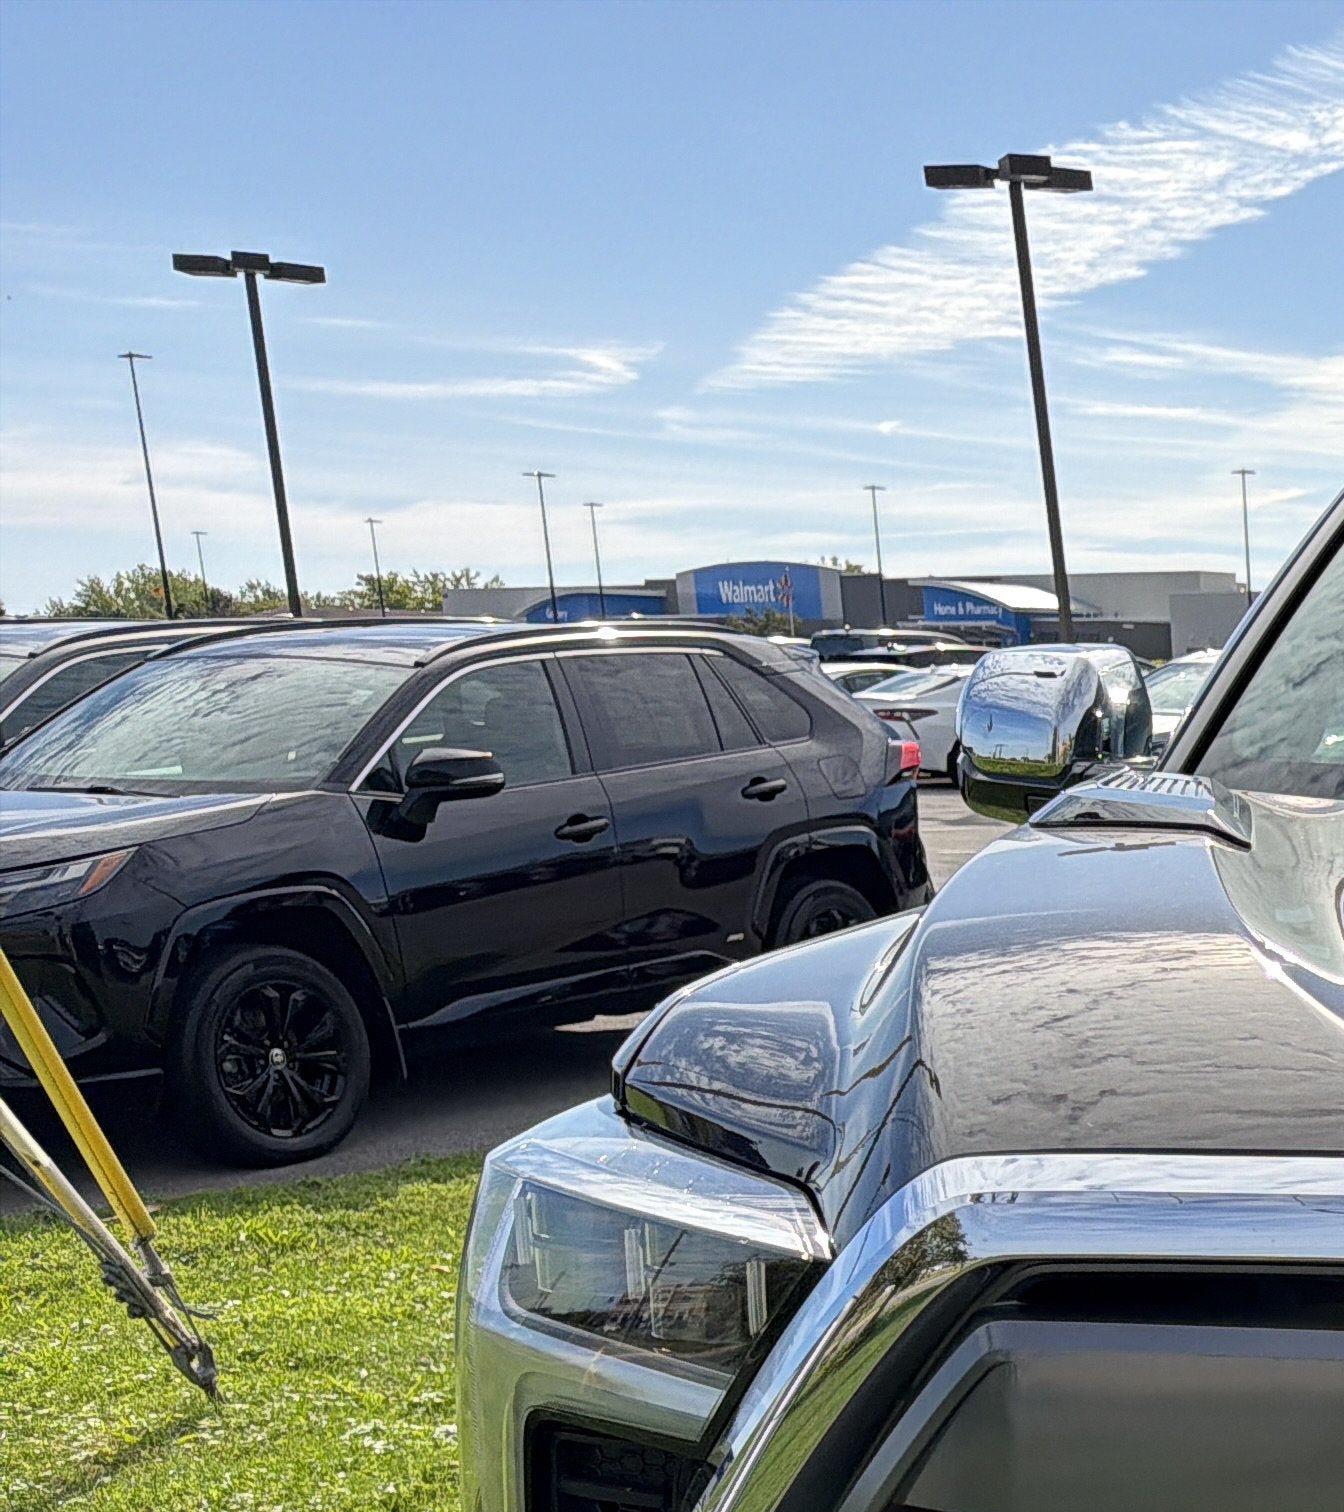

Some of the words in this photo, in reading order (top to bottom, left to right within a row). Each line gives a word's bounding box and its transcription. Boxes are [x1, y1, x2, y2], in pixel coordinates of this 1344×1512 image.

[718, 579, 776, 604] Walmart
[933, 602, 956, 615] Home
[957, 601, 964, 615] &
[965, 601, 1003, 619] Pharmacy
